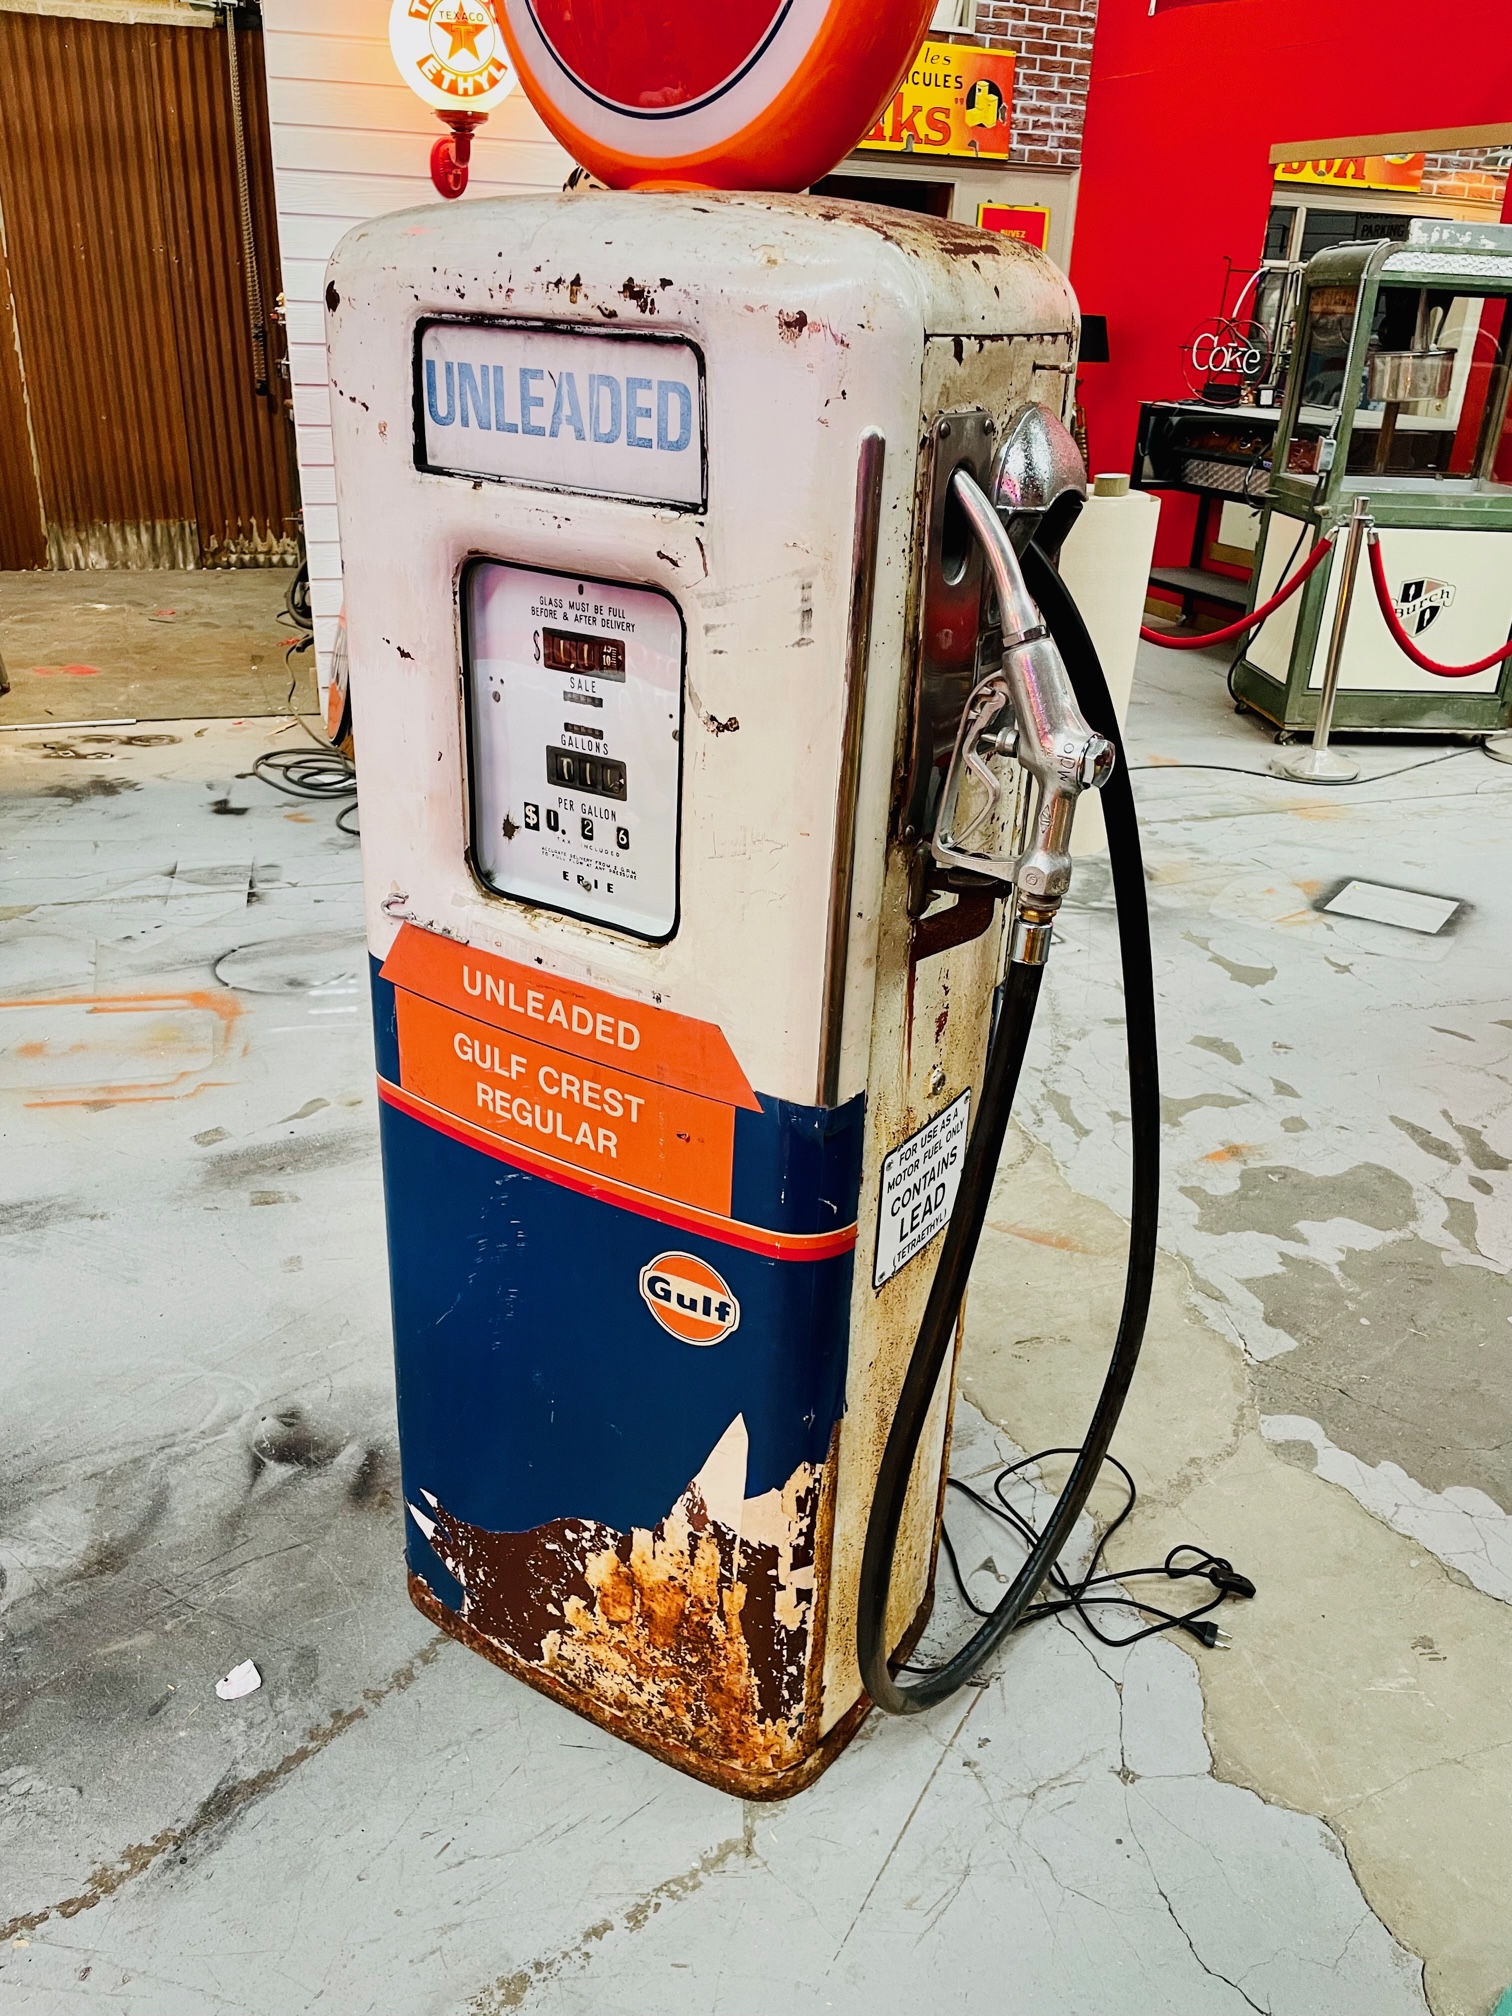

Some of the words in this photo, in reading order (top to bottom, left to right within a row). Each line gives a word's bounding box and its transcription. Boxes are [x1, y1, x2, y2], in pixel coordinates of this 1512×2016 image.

[439, 10, 484, 22] TEXACO
[924, 48, 952, 66] les
[420, 57, 506, 95] ETHYL
[1361, 223, 1405, 238] PARKING
[1192, 333, 1261, 374] Coke
[425, 359, 692, 452] UNLEADED
[531, 606, 558, 620] BEFORE
[562, 611, 569, 621] &
[573, 613, 597, 626] AFTER
[601, 618, 636, 633] DELIVERY
[539, 595, 564, 609] GLASS
[568, 600, 590, 613] MUST
[594, 604, 604, 616] BE
[608, 607, 626, 619] FULL
[1394, 589, 1450, 618] Burch
[569, 676, 597, 694] SALE
[560, 733, 609, 756] GALLONS
[557, 796, 575, 812] PER
[581, 802, 617, 822] GALLON
[556, 836, 572, 845] TAX
[580, 843, 621, 858] INCLUDED
[562, 870, 615, 894] ERIE
[462, 965, 641, 1051] UNLEADED
[453, 1032, 528, 1081] GULF
[537, 1065, 645, 1124] CREST
[475, 1081, 618, 1159] REGULAR
[899, 1142, 918, 1167] FOR
[920, 1129, 938, 1149] USE
[939, 1113, 952, 1133] AS
[952, 1107, 959, 1123] A
[886, 1162, 920, 1194] MOTOR
[922, 1141, 943, 1165] FUEL
[945, 1117, 965, 1143] ONLY
[890, 1145, 958, 1218] CONTAINS
[898, 1182, 946, 1244] LEAD
[647, 1275, 732, 1323] Gulf
